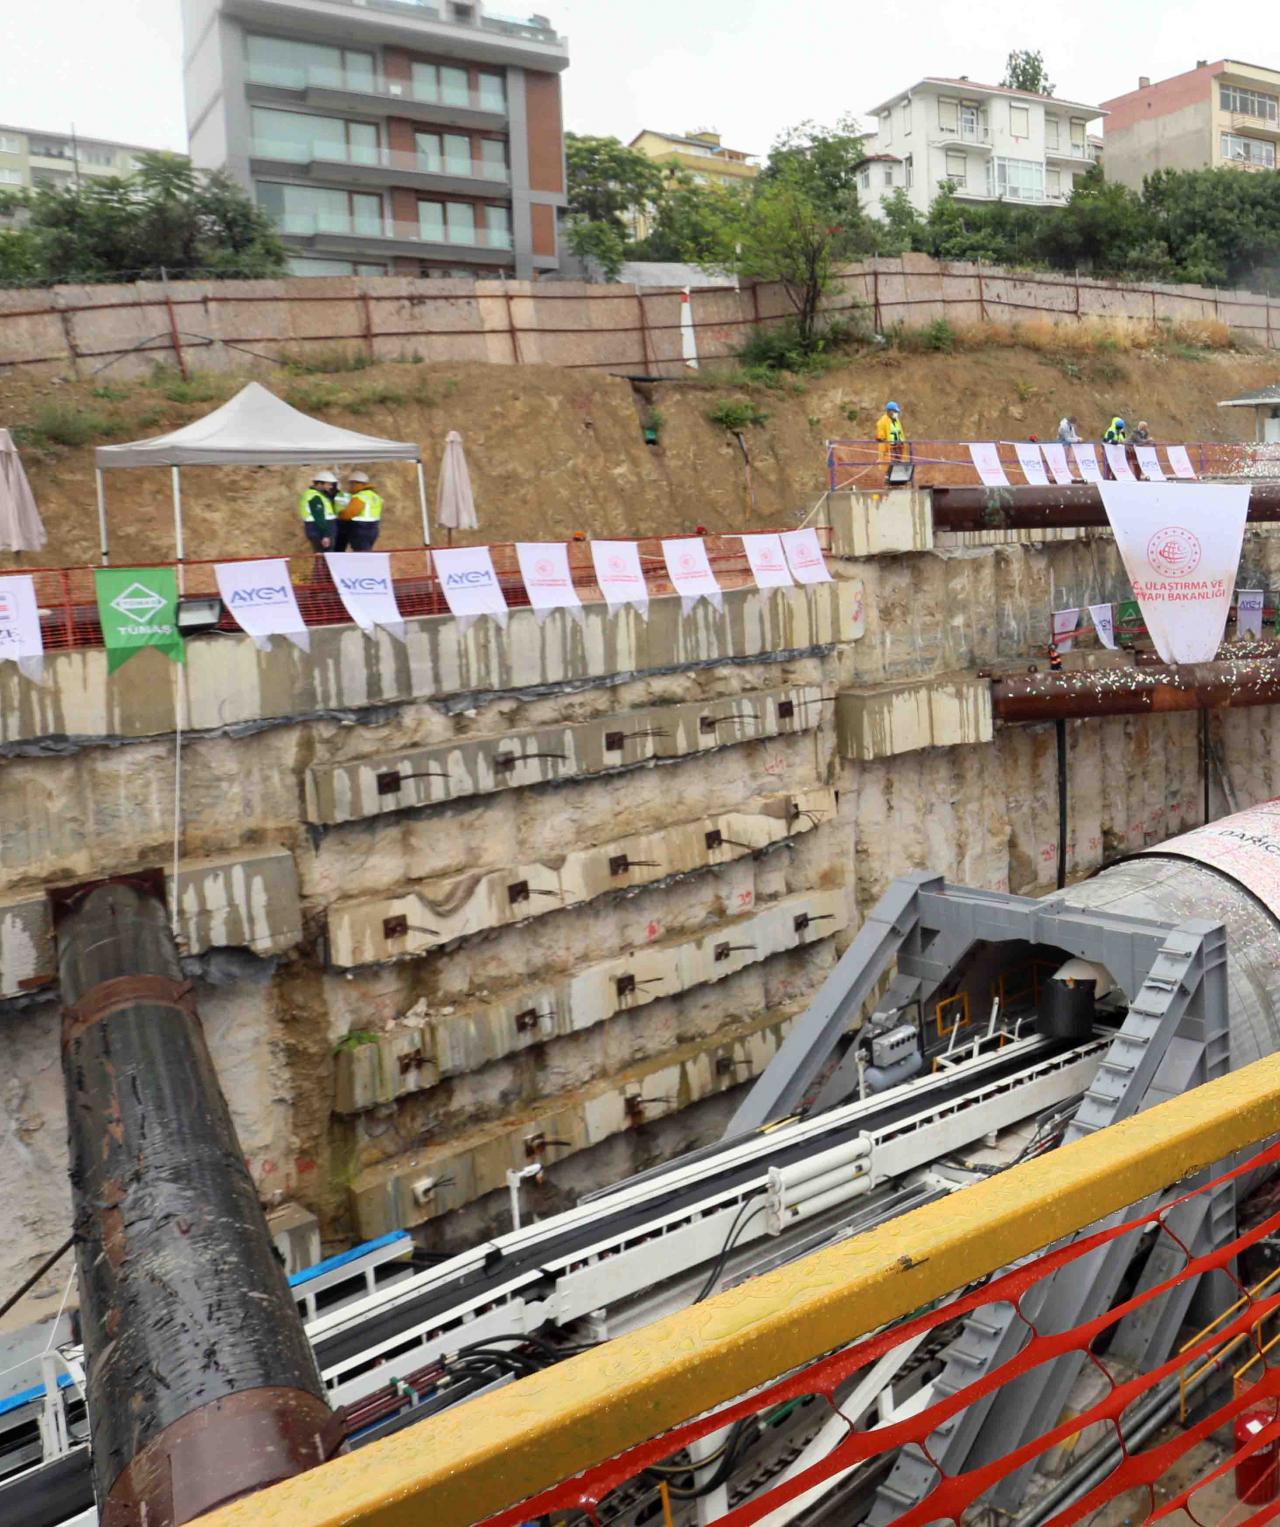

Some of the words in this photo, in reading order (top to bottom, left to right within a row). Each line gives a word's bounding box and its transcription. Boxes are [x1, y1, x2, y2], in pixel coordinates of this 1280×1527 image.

[1145, 580, 1208, 593] ULAŞTIRMA
[1210, 578, 1224, 589] VE
[1167, 588, 1225, 602] BAKANLIĞI
